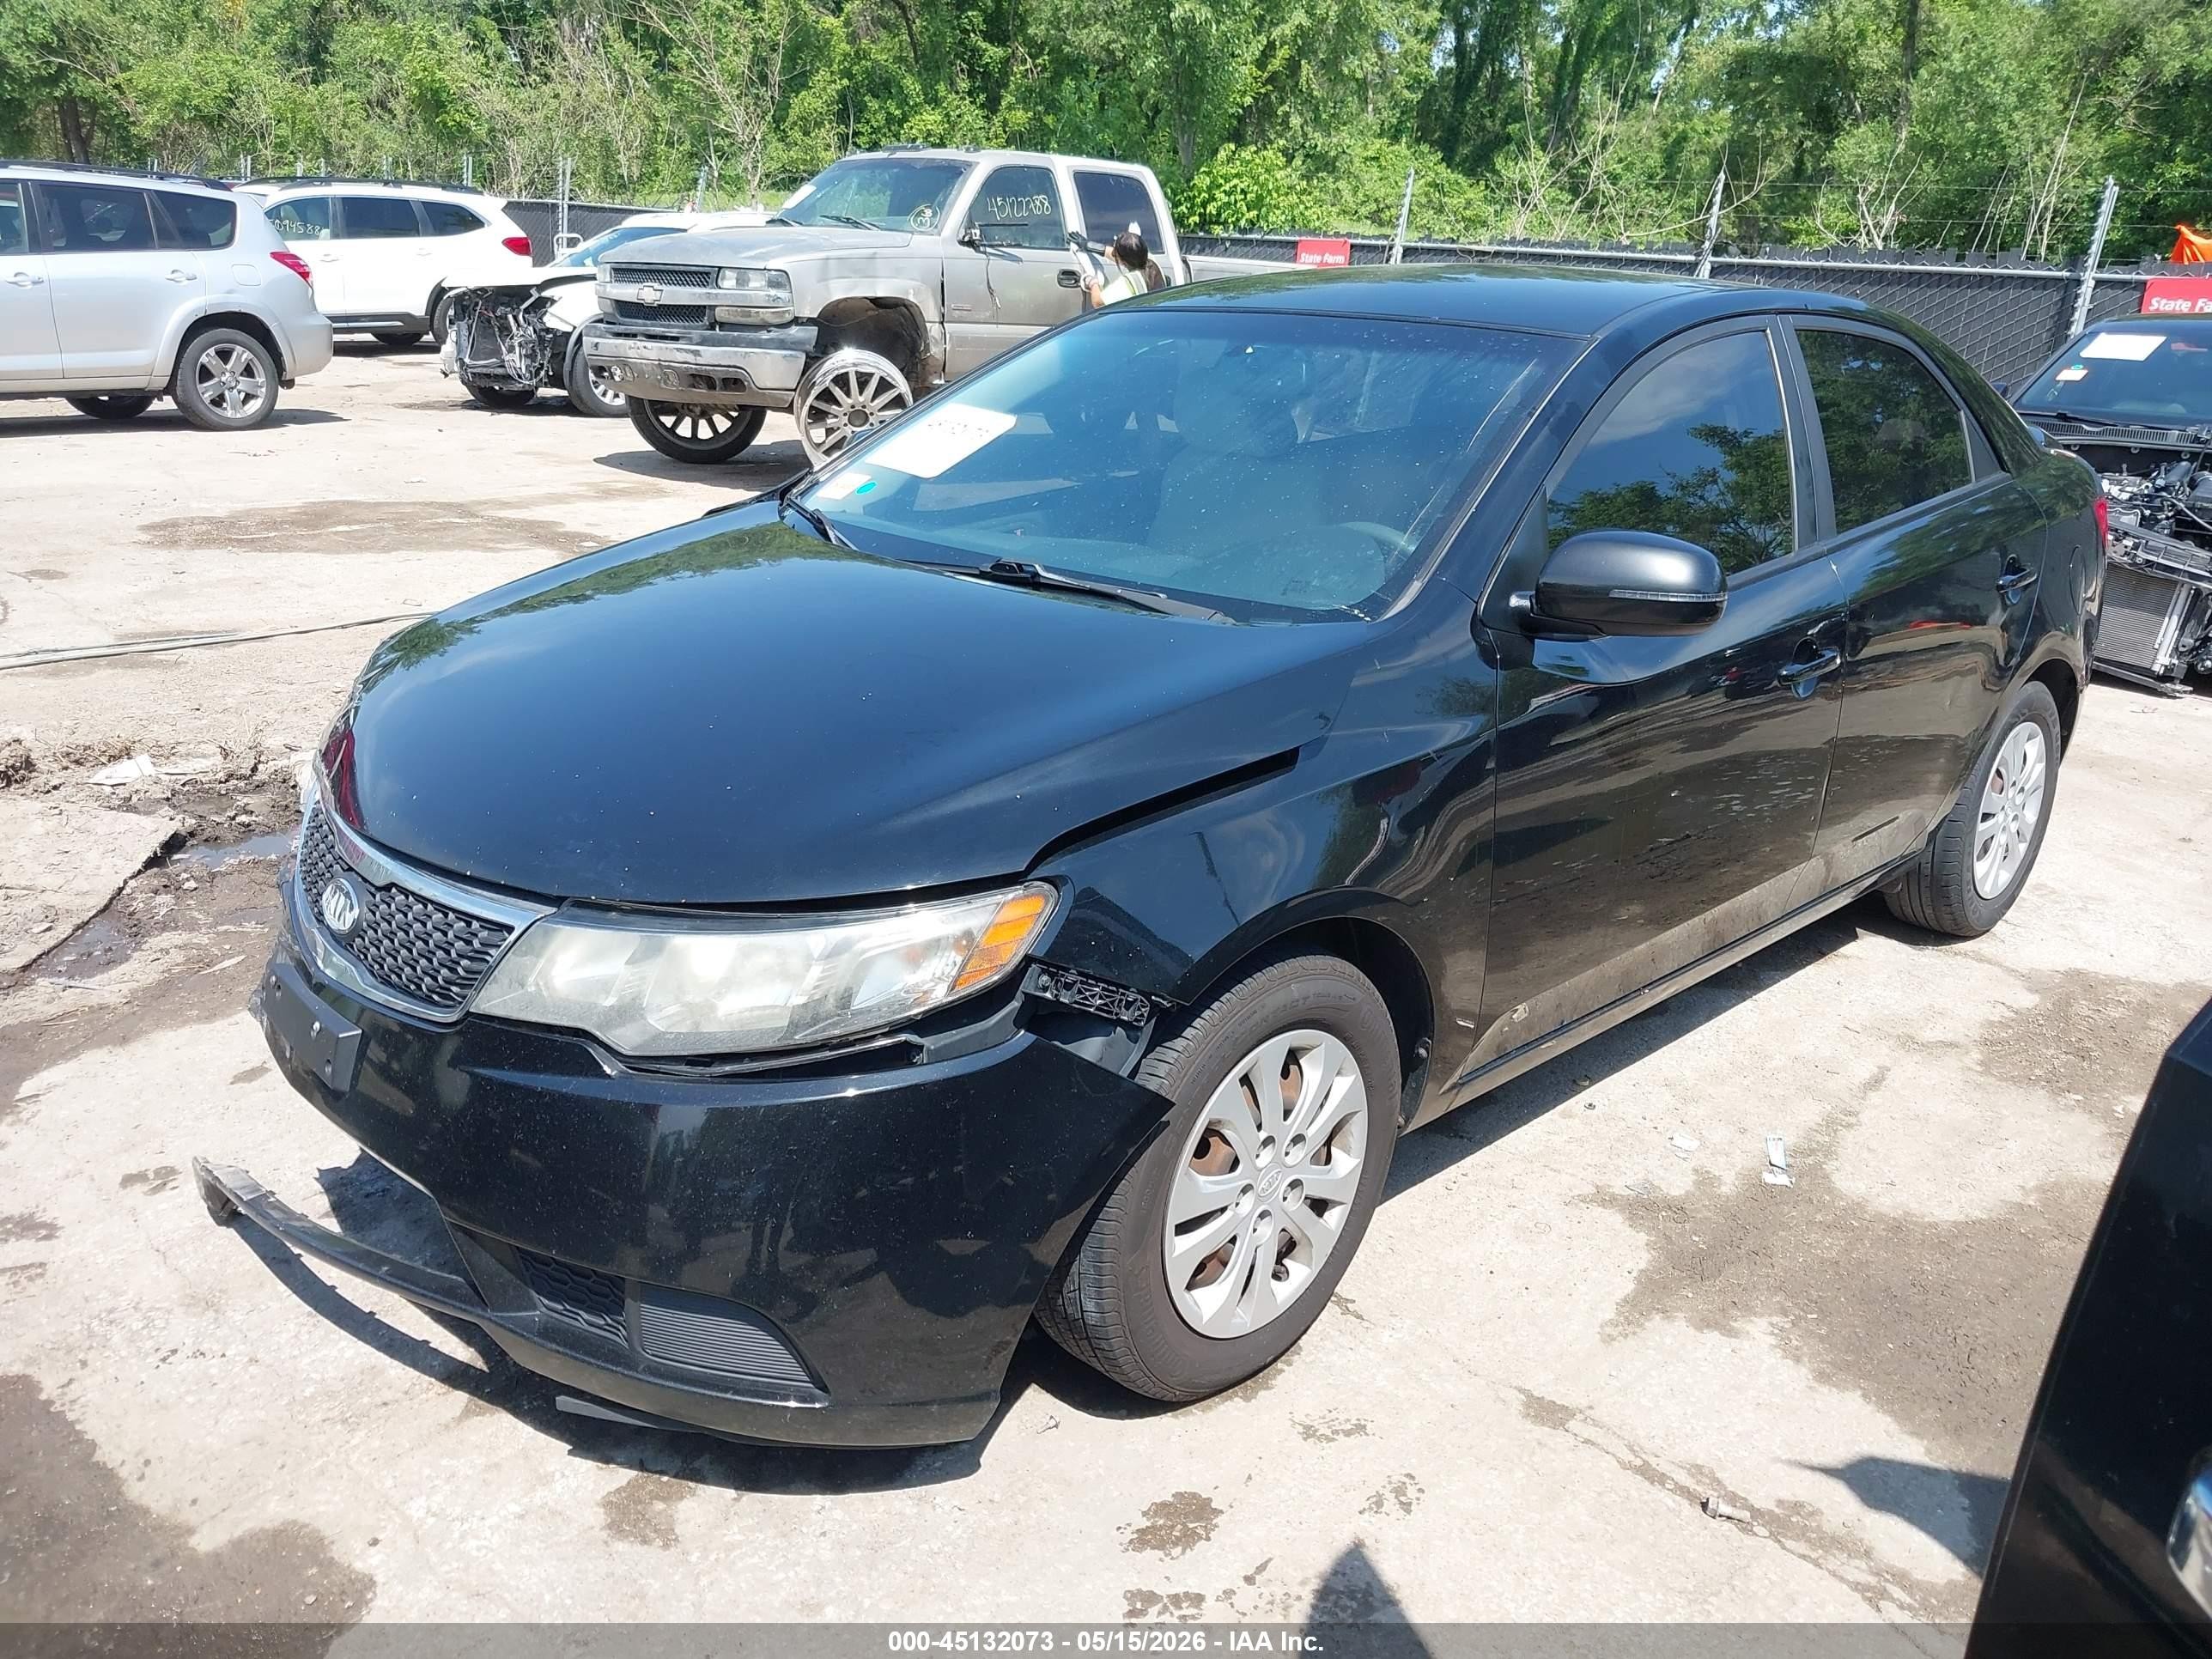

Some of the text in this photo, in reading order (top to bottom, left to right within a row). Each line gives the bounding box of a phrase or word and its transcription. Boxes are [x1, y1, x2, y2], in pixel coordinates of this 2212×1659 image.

[987, 195, 1052, 221] 45122788
[1300, 252, 1346, 264] State Farm
[2148, 297, 2192, 312] State
